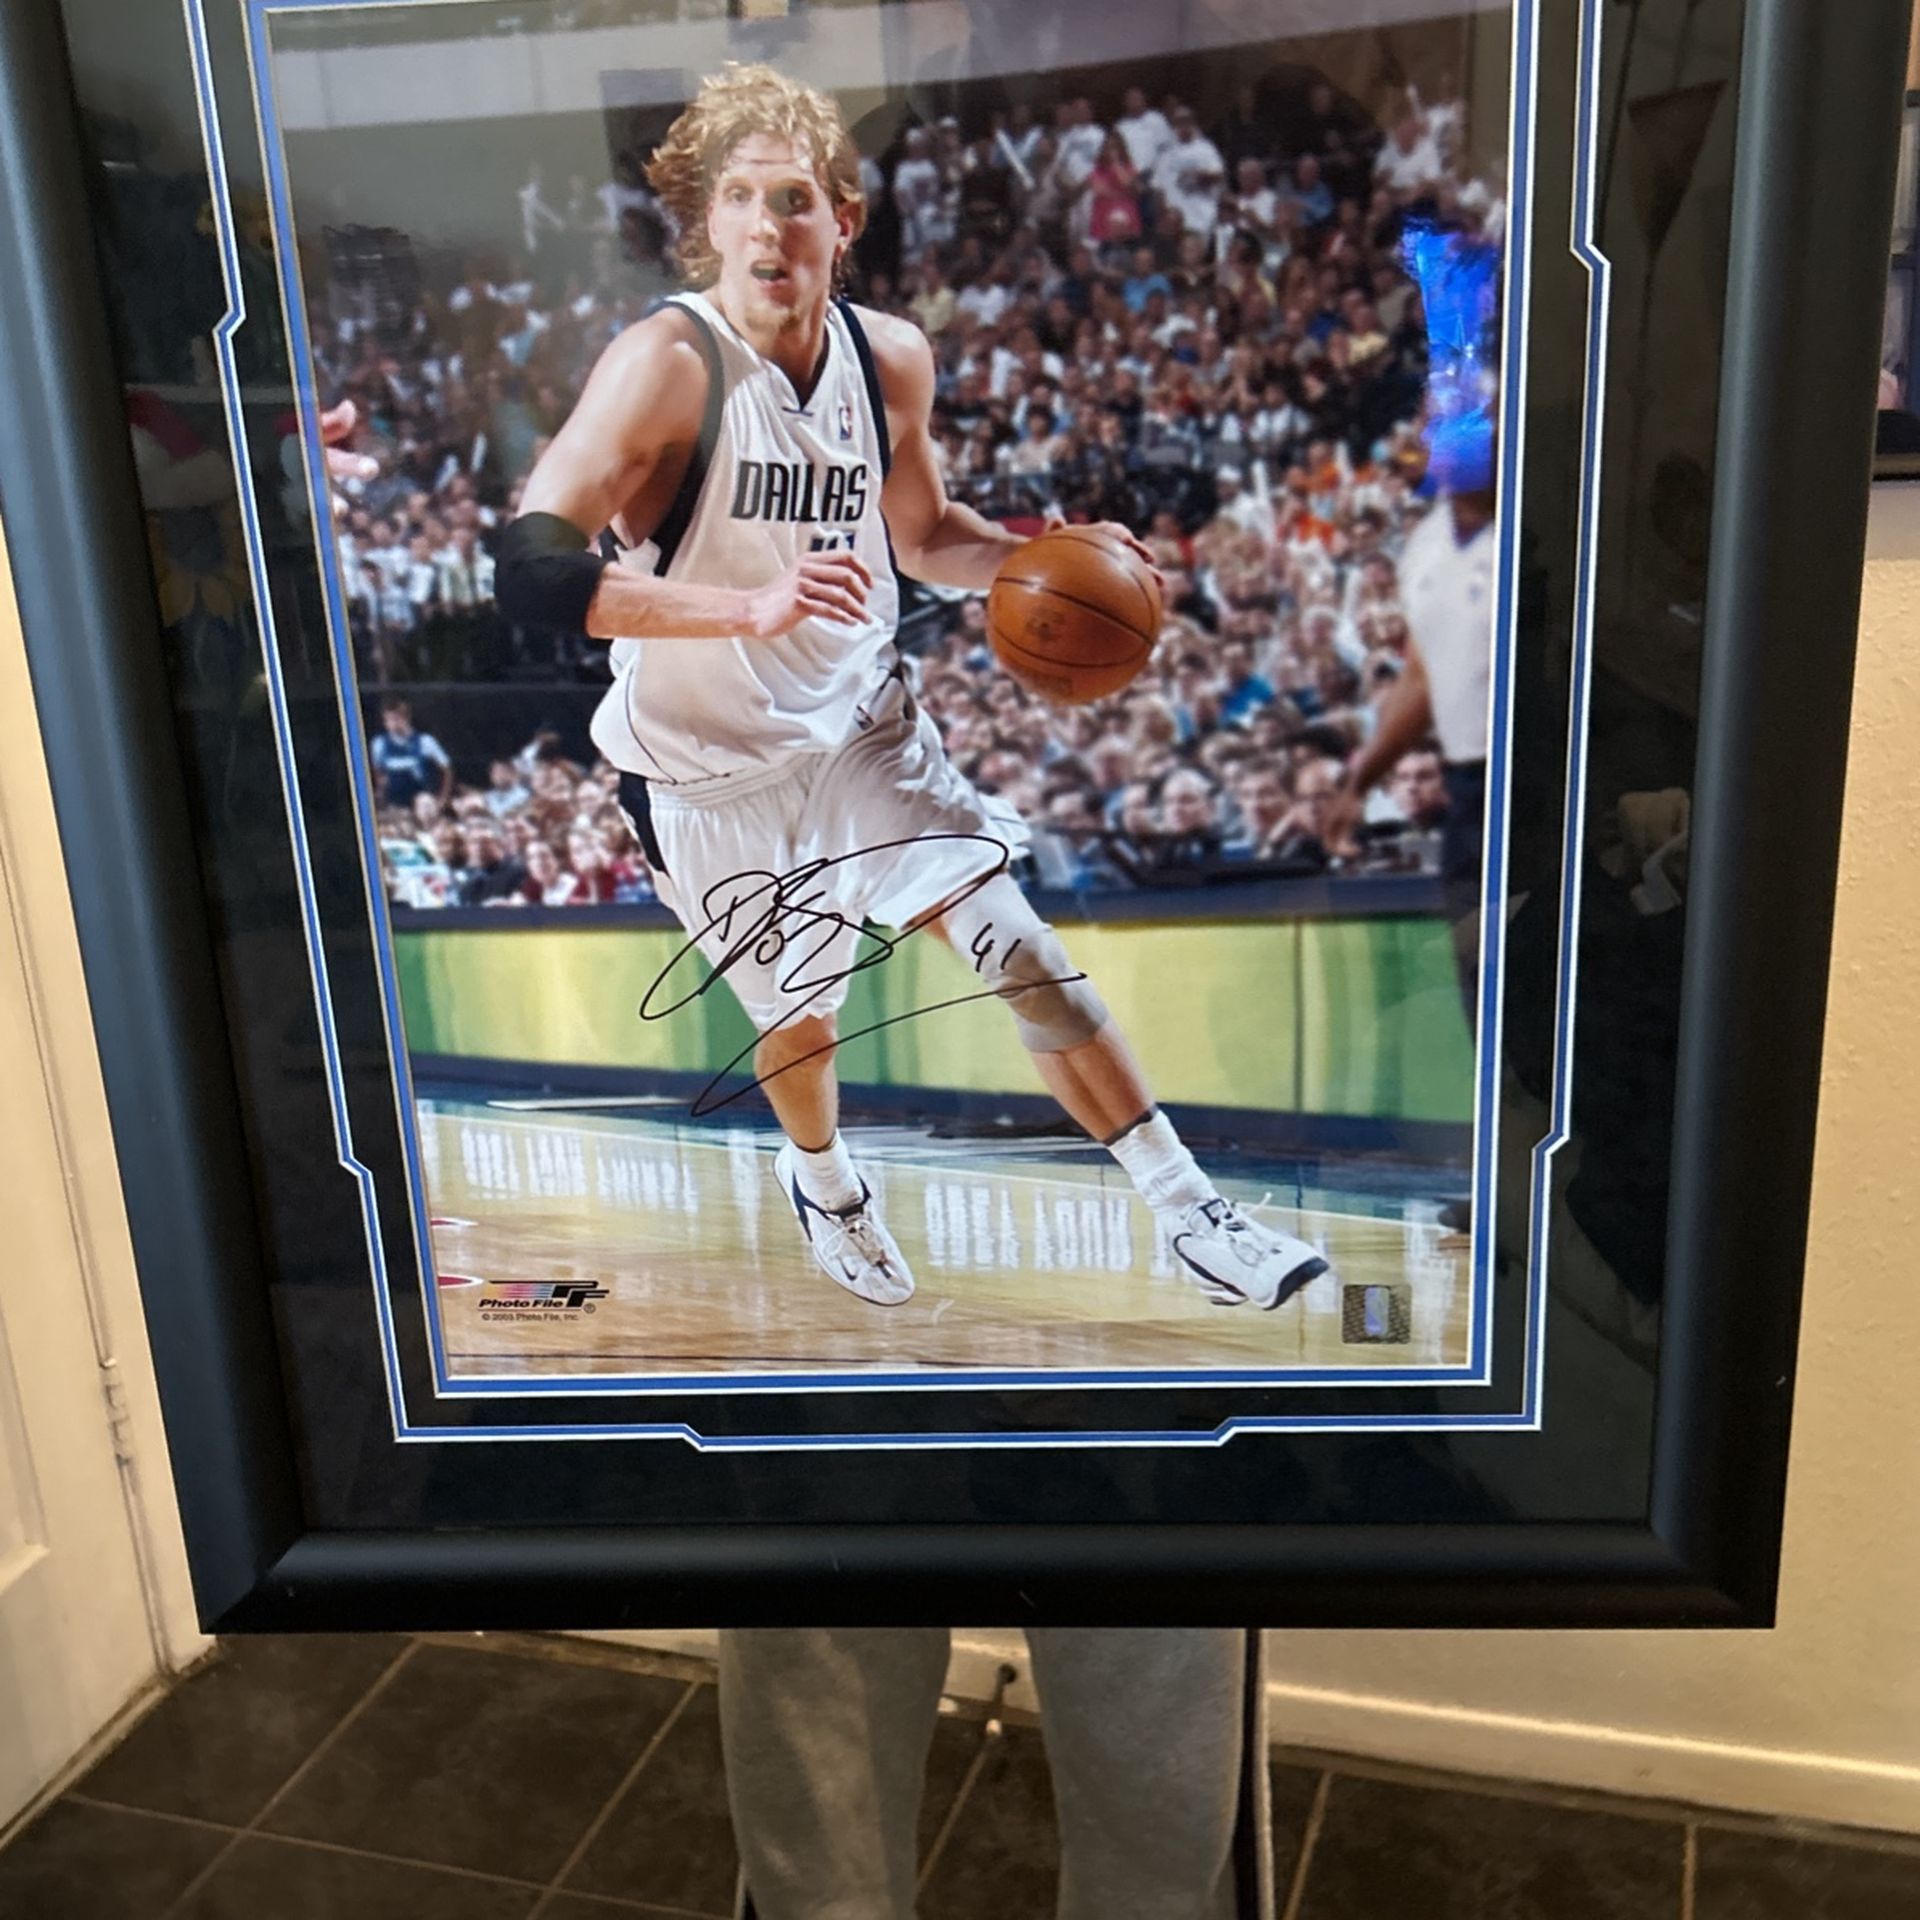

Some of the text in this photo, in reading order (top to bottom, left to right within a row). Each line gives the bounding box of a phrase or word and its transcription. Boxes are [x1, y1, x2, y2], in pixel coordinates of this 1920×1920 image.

[731, 460, 867, 522] DALLAS
[971, 922, 1022, 973] 41
[478, 1298, 564, 1308] Photo File
[516, 1312, 542, 1321] Photo
